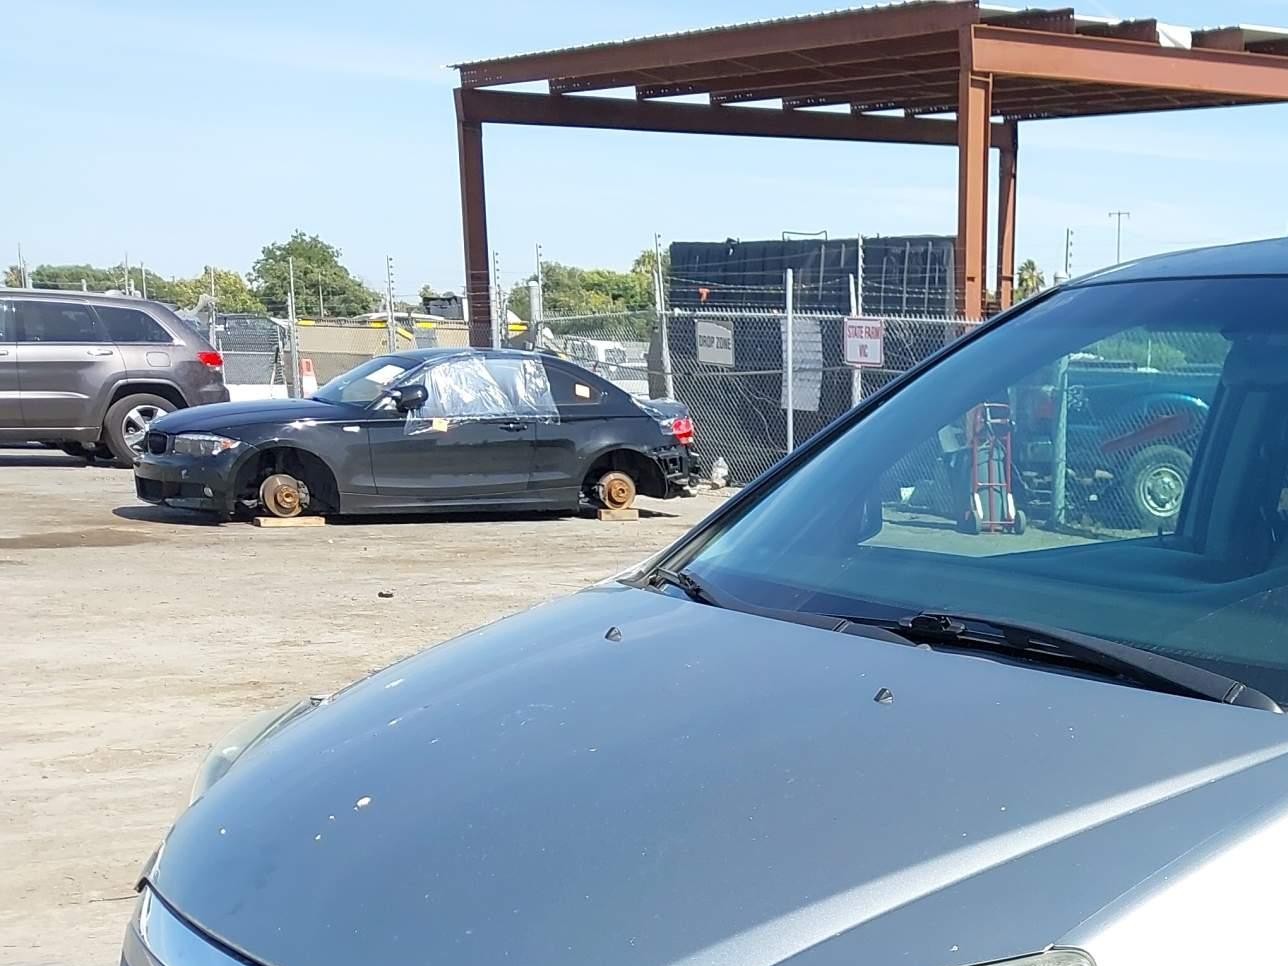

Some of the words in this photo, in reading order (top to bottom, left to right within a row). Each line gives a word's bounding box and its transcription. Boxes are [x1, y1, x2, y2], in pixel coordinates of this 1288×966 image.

[847, 325, 864, 339] STATE
[698, 335, 714, 348] DROP
[715, 336, 731, 350] ZONE
